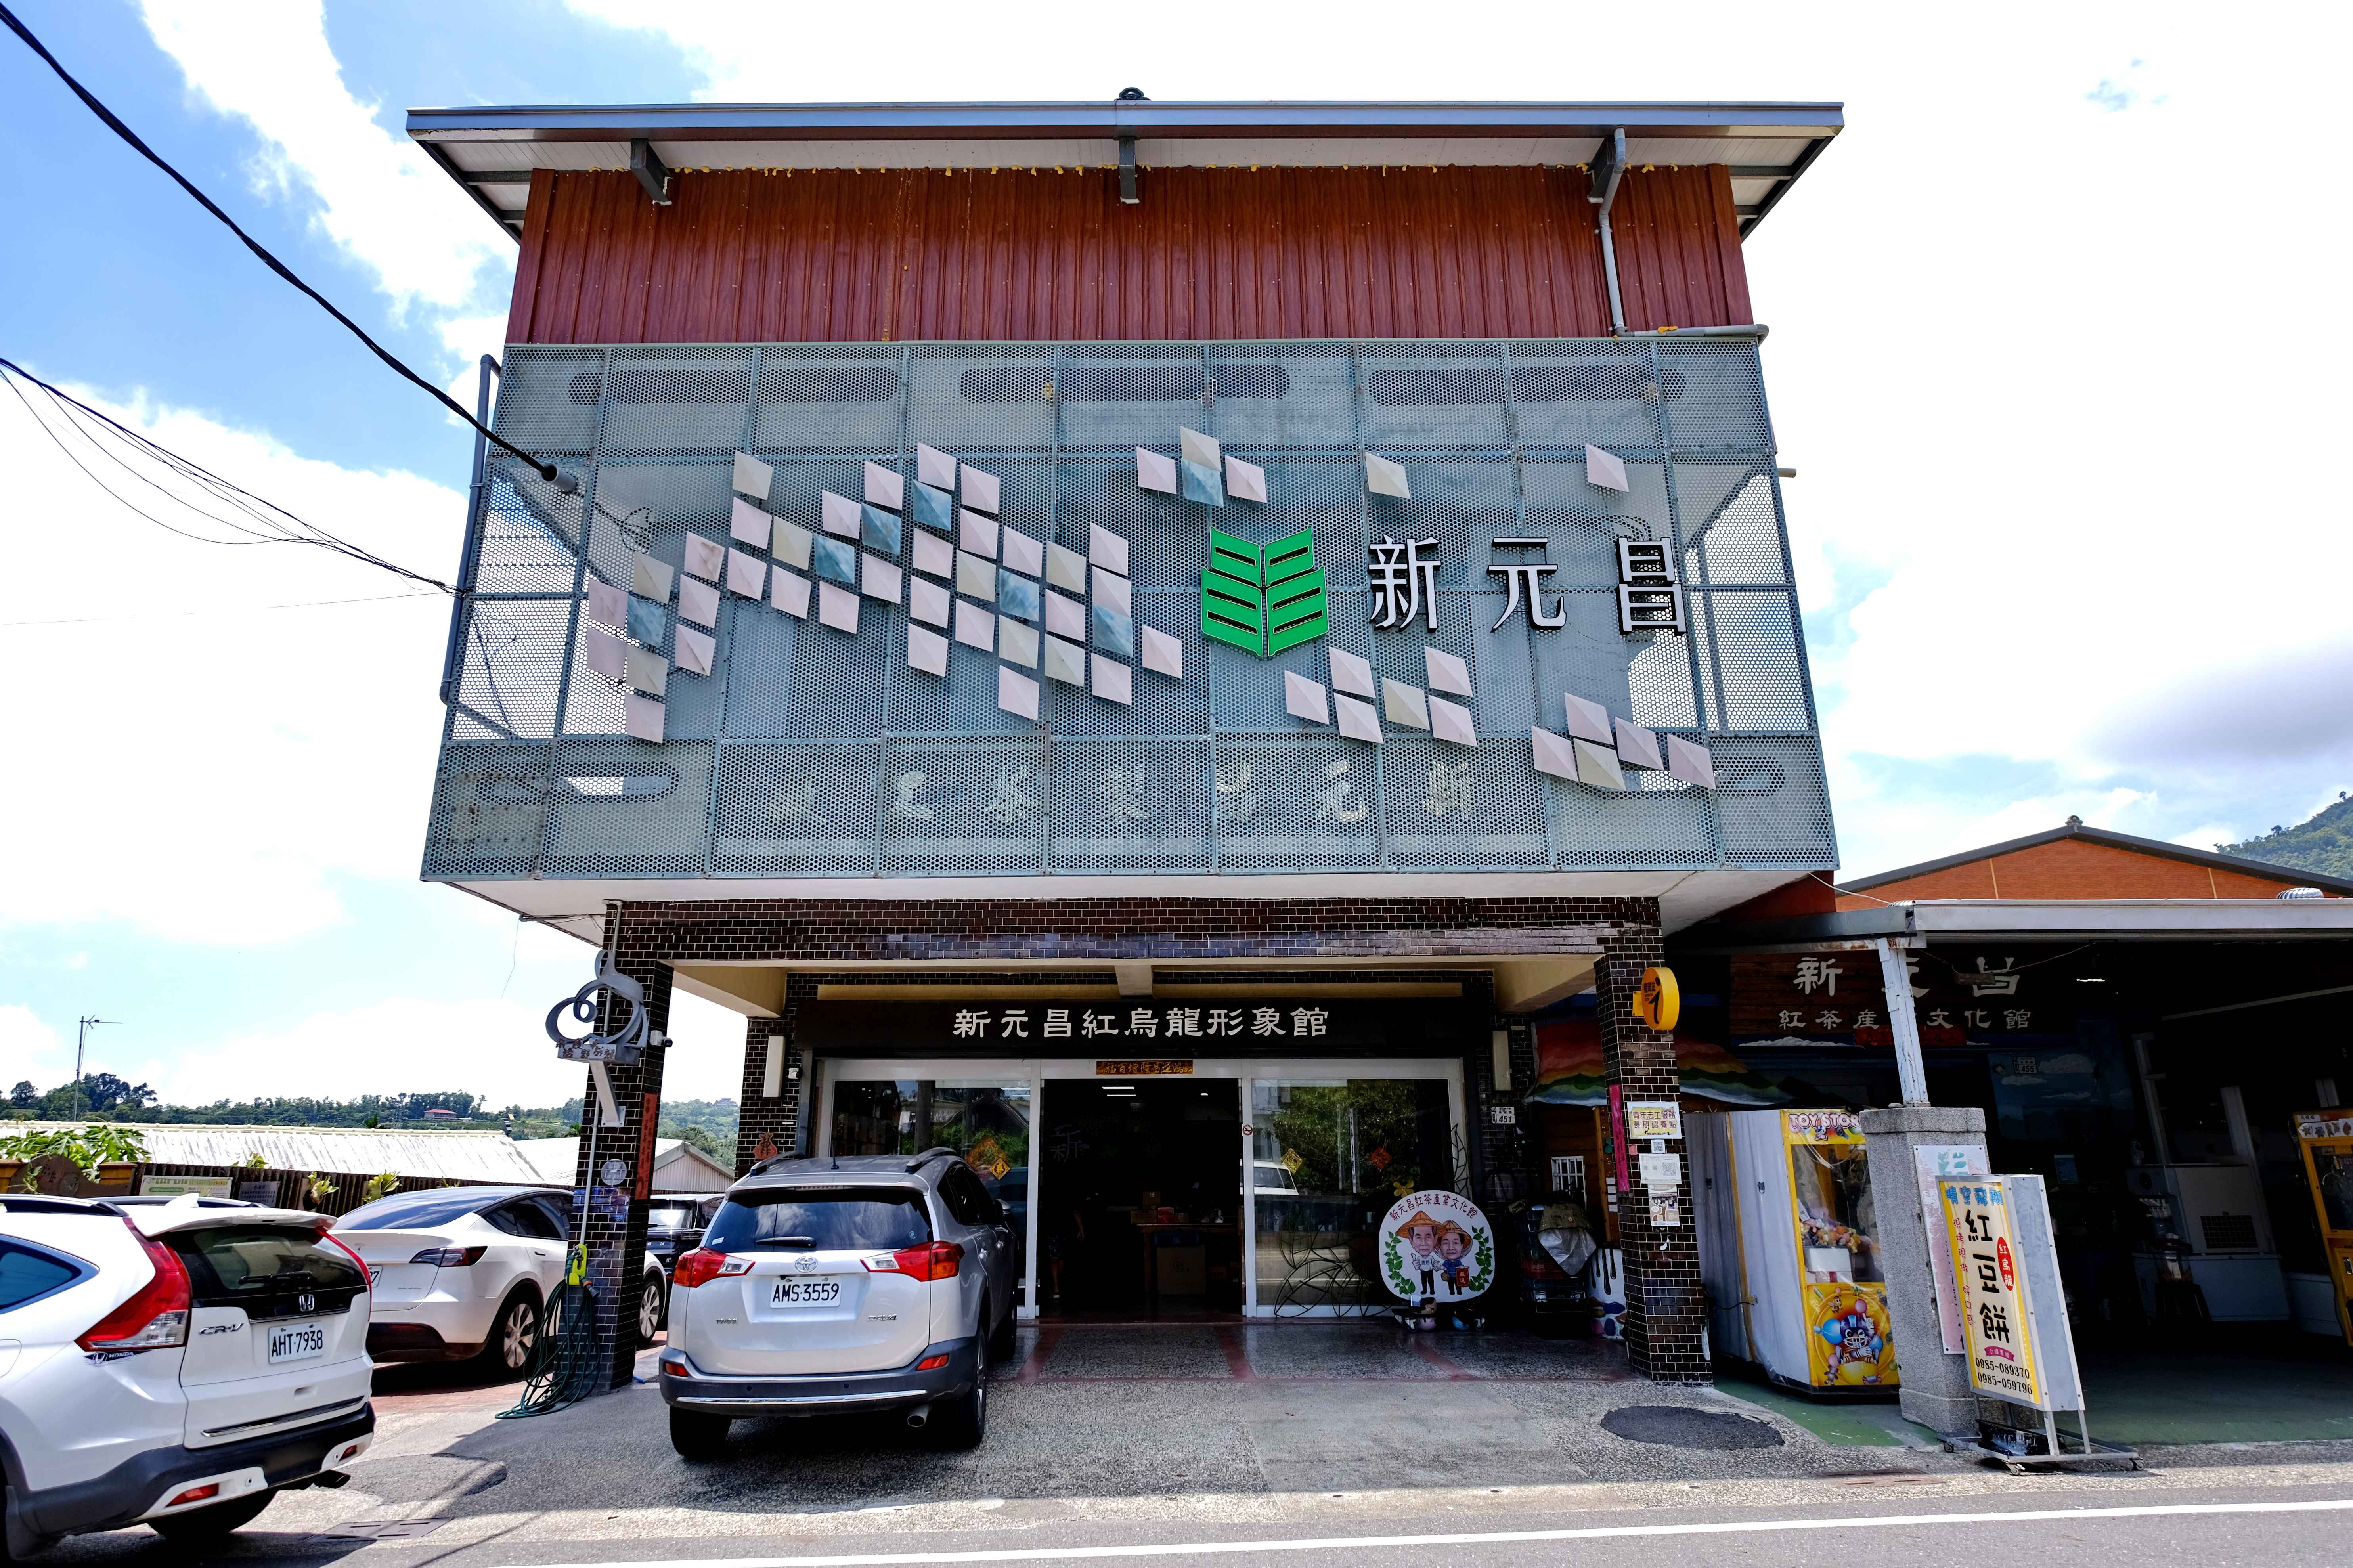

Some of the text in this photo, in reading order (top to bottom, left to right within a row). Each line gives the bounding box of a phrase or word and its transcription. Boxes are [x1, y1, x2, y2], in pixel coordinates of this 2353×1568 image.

[1369, 534, 1686, 635] 新元昌
[953, 1007, 1330, 1038] 新元昌紅烏龍形象館
[1633, 1110, 1676, 1119] 青年志工服務
[1788, 1113, 1860, 1128] TOY STOR
[1965, 1209, 2010, 1343] 紅豆餅
[199, 1323, 244, 1335] CR-V
[1976, 1358, 2030, 1379] 0985-089370
[1978, 1372, 2032, 1394] 0985-059796
